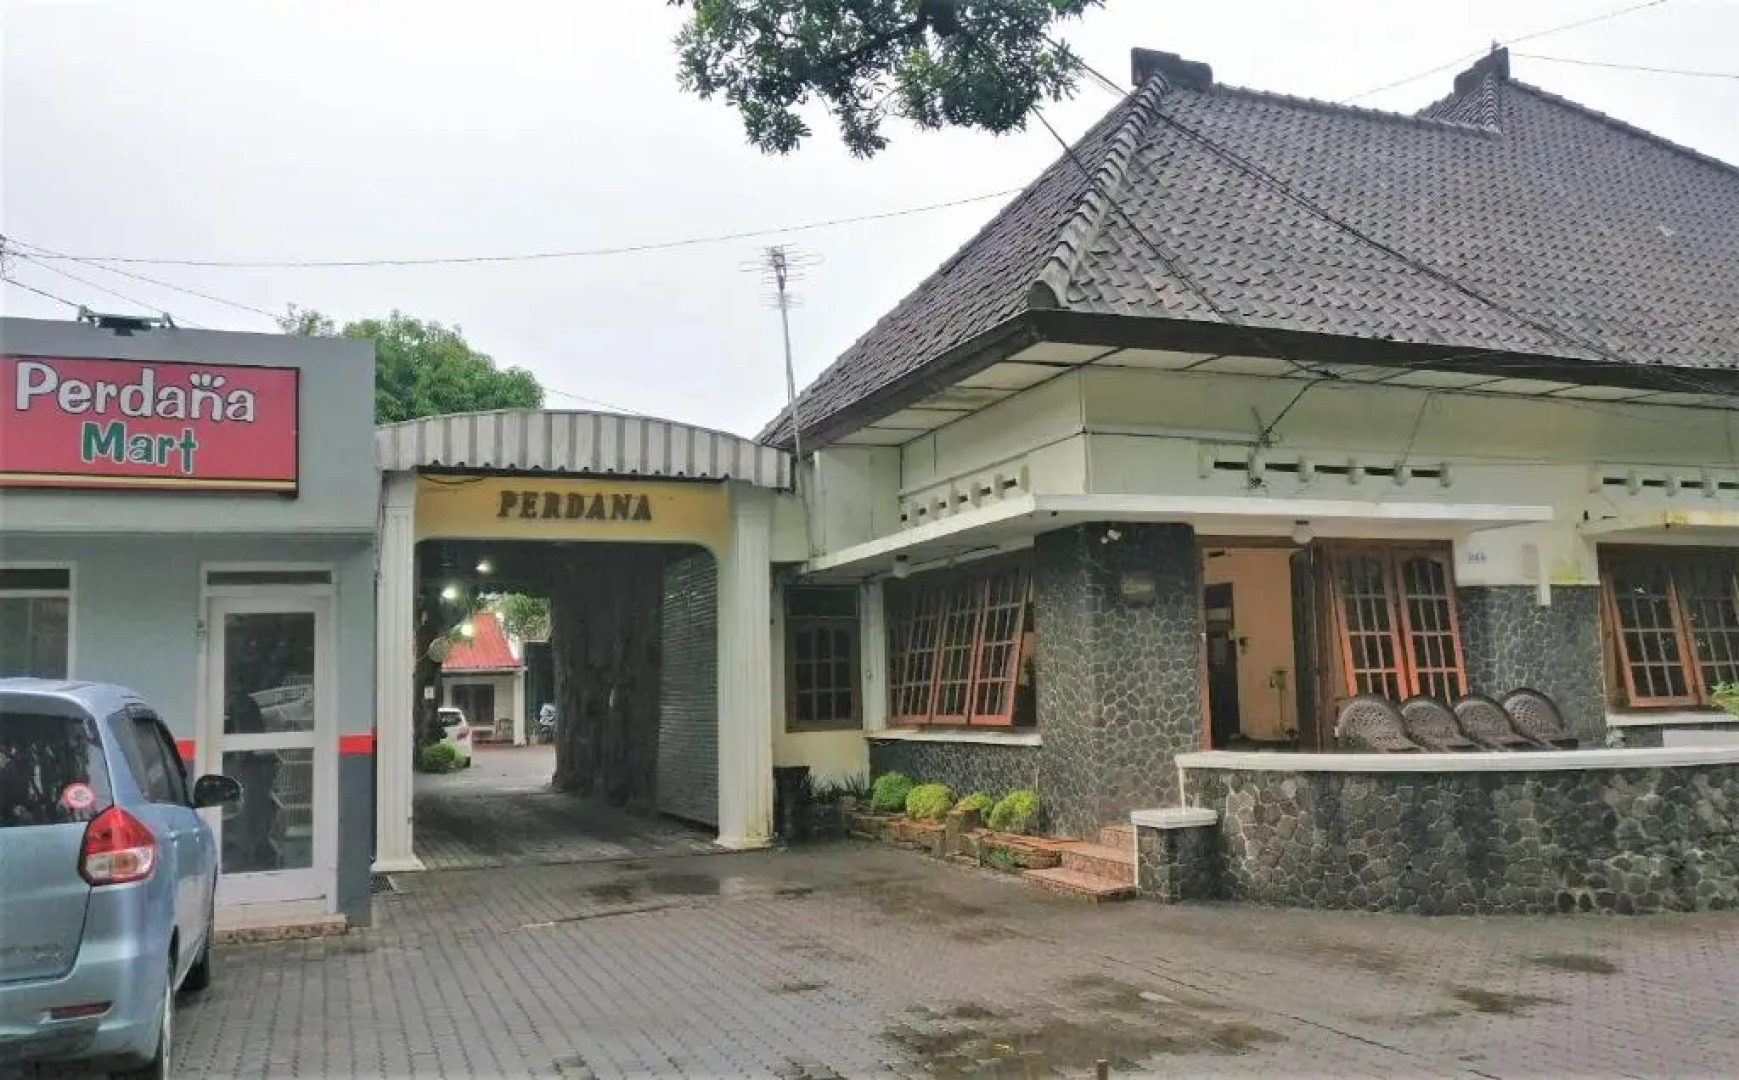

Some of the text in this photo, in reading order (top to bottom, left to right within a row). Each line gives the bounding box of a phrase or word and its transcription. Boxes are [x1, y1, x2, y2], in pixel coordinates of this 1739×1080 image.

[15, 361, 255, 422] Perdana
[81, 420, 198, 474] Mart
[496, 490, 653, 521] PERDANA
